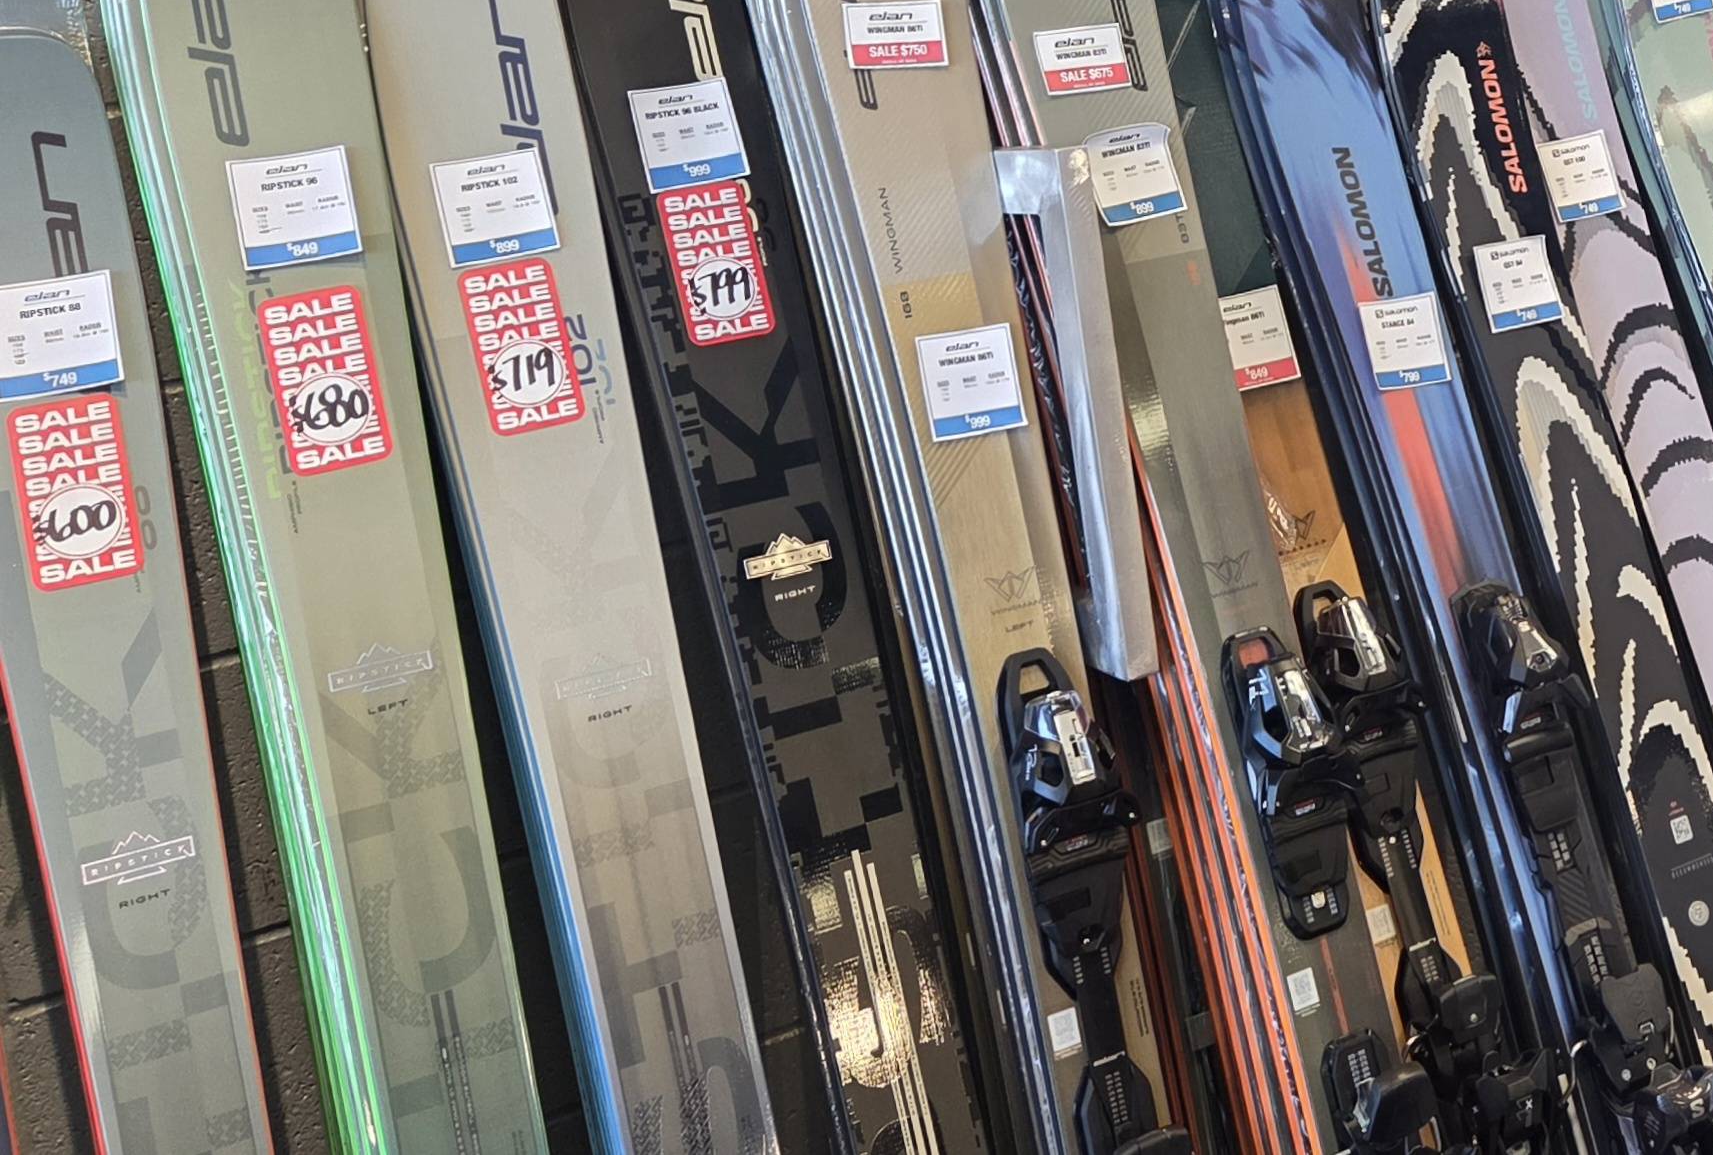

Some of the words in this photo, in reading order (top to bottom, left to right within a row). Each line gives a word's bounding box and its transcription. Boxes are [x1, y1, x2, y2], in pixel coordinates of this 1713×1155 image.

[867, 25, 905, 34] WINGMAN
[869, 46, 899, 57] SALE
[901, 45, 928, 57] $750
[1056, 49, 1091, 60] WINGMAN
[1060, 70, 1087, 83] SALE
[1089, 67, 1114, 80] $675
[645, 109, 680, 120] RIPSTICK
[694, 102, 719, 116] BLACK
[1479, 59, 1528, 194] SALOMON
[1102, 144, 1135, 159] WINGMAN
[261, 178, 304, 192] RIPSTICK
[461, 180, 500, 193] RIPSTICK
[664, 187, 738, 213] SALE
[668, 206, 742, 231] SALE
[1332, 147, 1393, 297] SALOMON
[673, 223, 747, 248] SALE
[286, 241, 318, 257] $849
[677, 241, 750, 267] SALE
[464, 265, 546, 294] SALE
[264, 293, 353, 324] SALE
[469, 284, 550, 313] SALE
[20, 304, 66, 320] RIPSTICK
[474, 303, 555, 332] SALE
[268, 313, 358, 345] SALE
[479, 321, 560, 351] SALE
[694, 313, 769, 340] SALE
[274, 334, 363, 366] SALE
[938, 356, 977, 368] WINGMAN
[43, 371, 78, 389] $749
[278, 354, 367, 385] SALE
[15, 401, 111, 433] SALE
[498, 399, 579, 430] SALE
[18, 422, 115, 455] SALE
[22, 443, 118, 476] SALE
[296, 436, 385, 469] SALE
[26, 464, 122, 498] SALE
[39, 549, 136, 584] SALE
[774, 584, 815, 602] RIGHT
[1005, 620, 1033, 633] LEFT
[368, 697, 408, 715] LEFT
[587, 705, 633, 722] RIGHT
[118, 888, 170, 909] RIGHT
